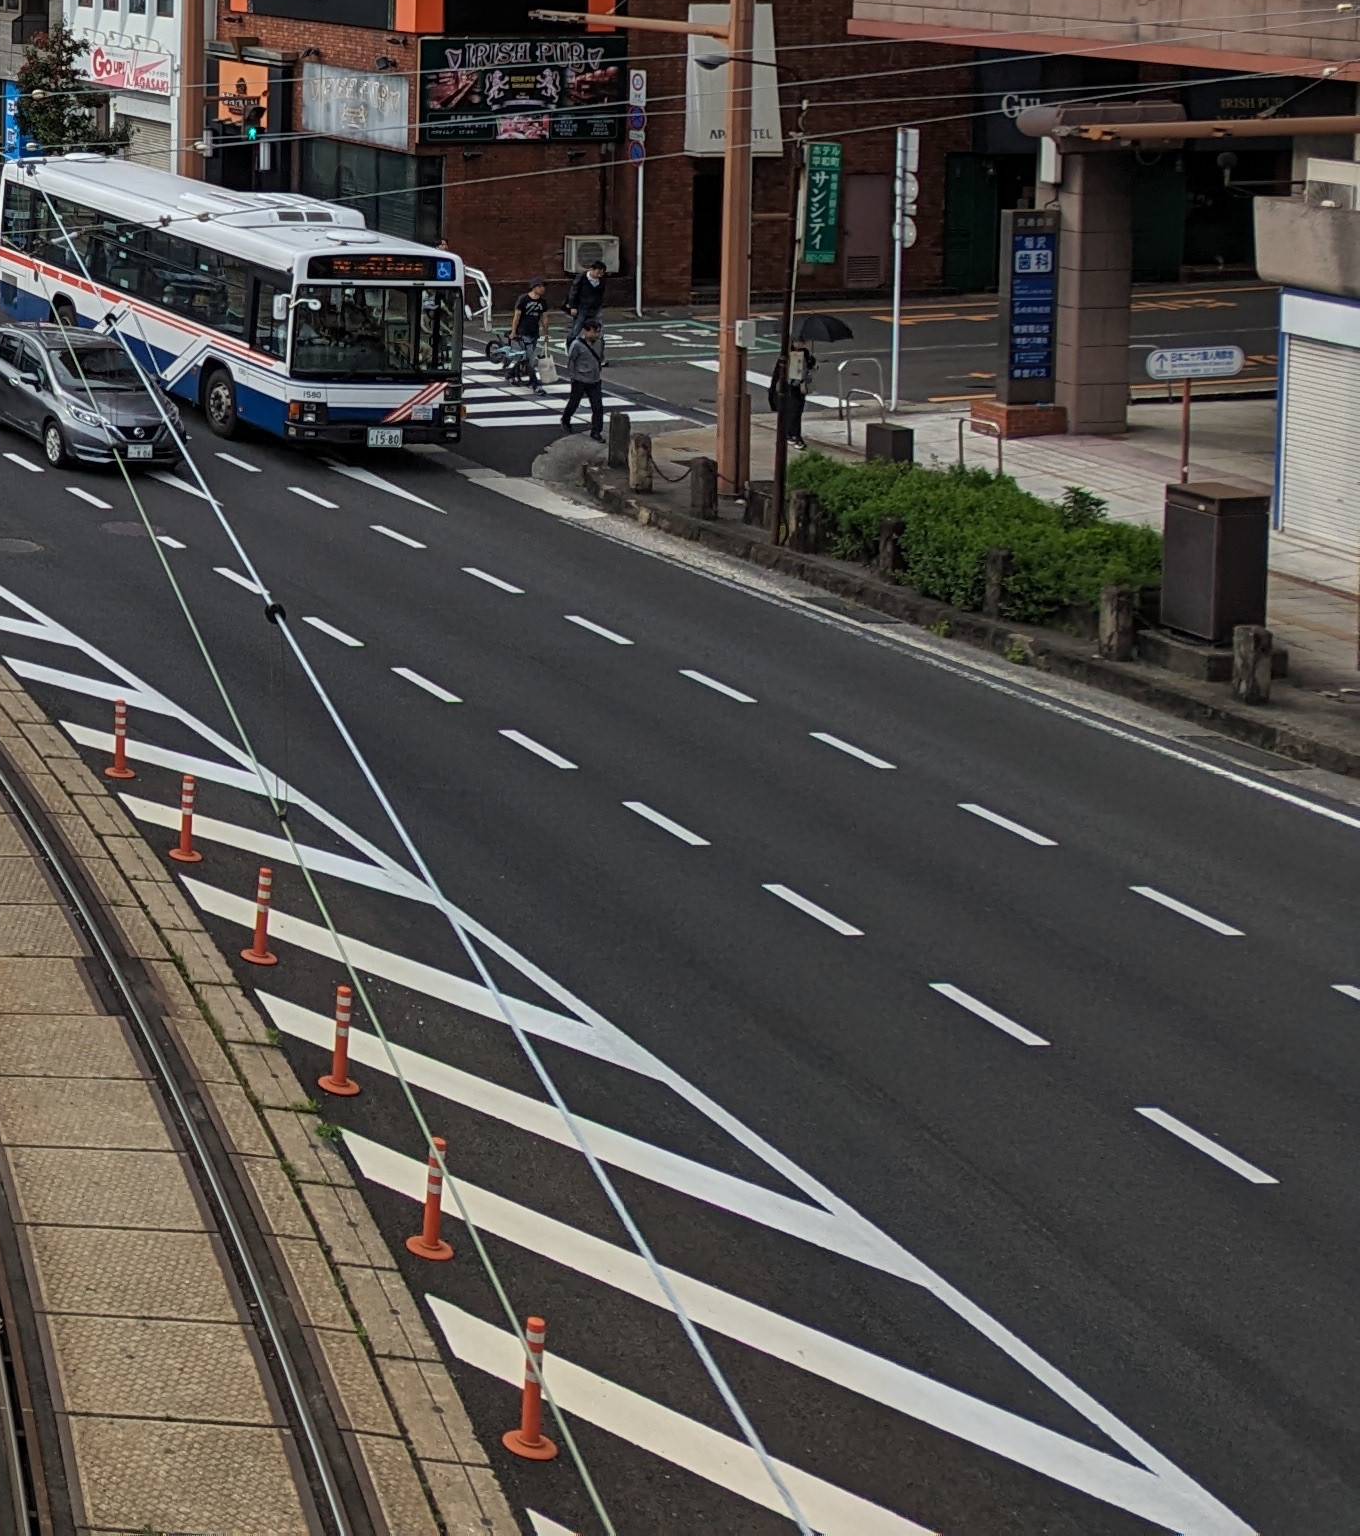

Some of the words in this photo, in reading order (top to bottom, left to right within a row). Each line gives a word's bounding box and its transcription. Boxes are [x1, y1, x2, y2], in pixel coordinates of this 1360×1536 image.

[464, 41, 532, 70] IRISH
[535, 41, 586, 73] PUB
[809, 170, 830, 250] サンシティ
[1018, 252, 1049, 270] 歯科
